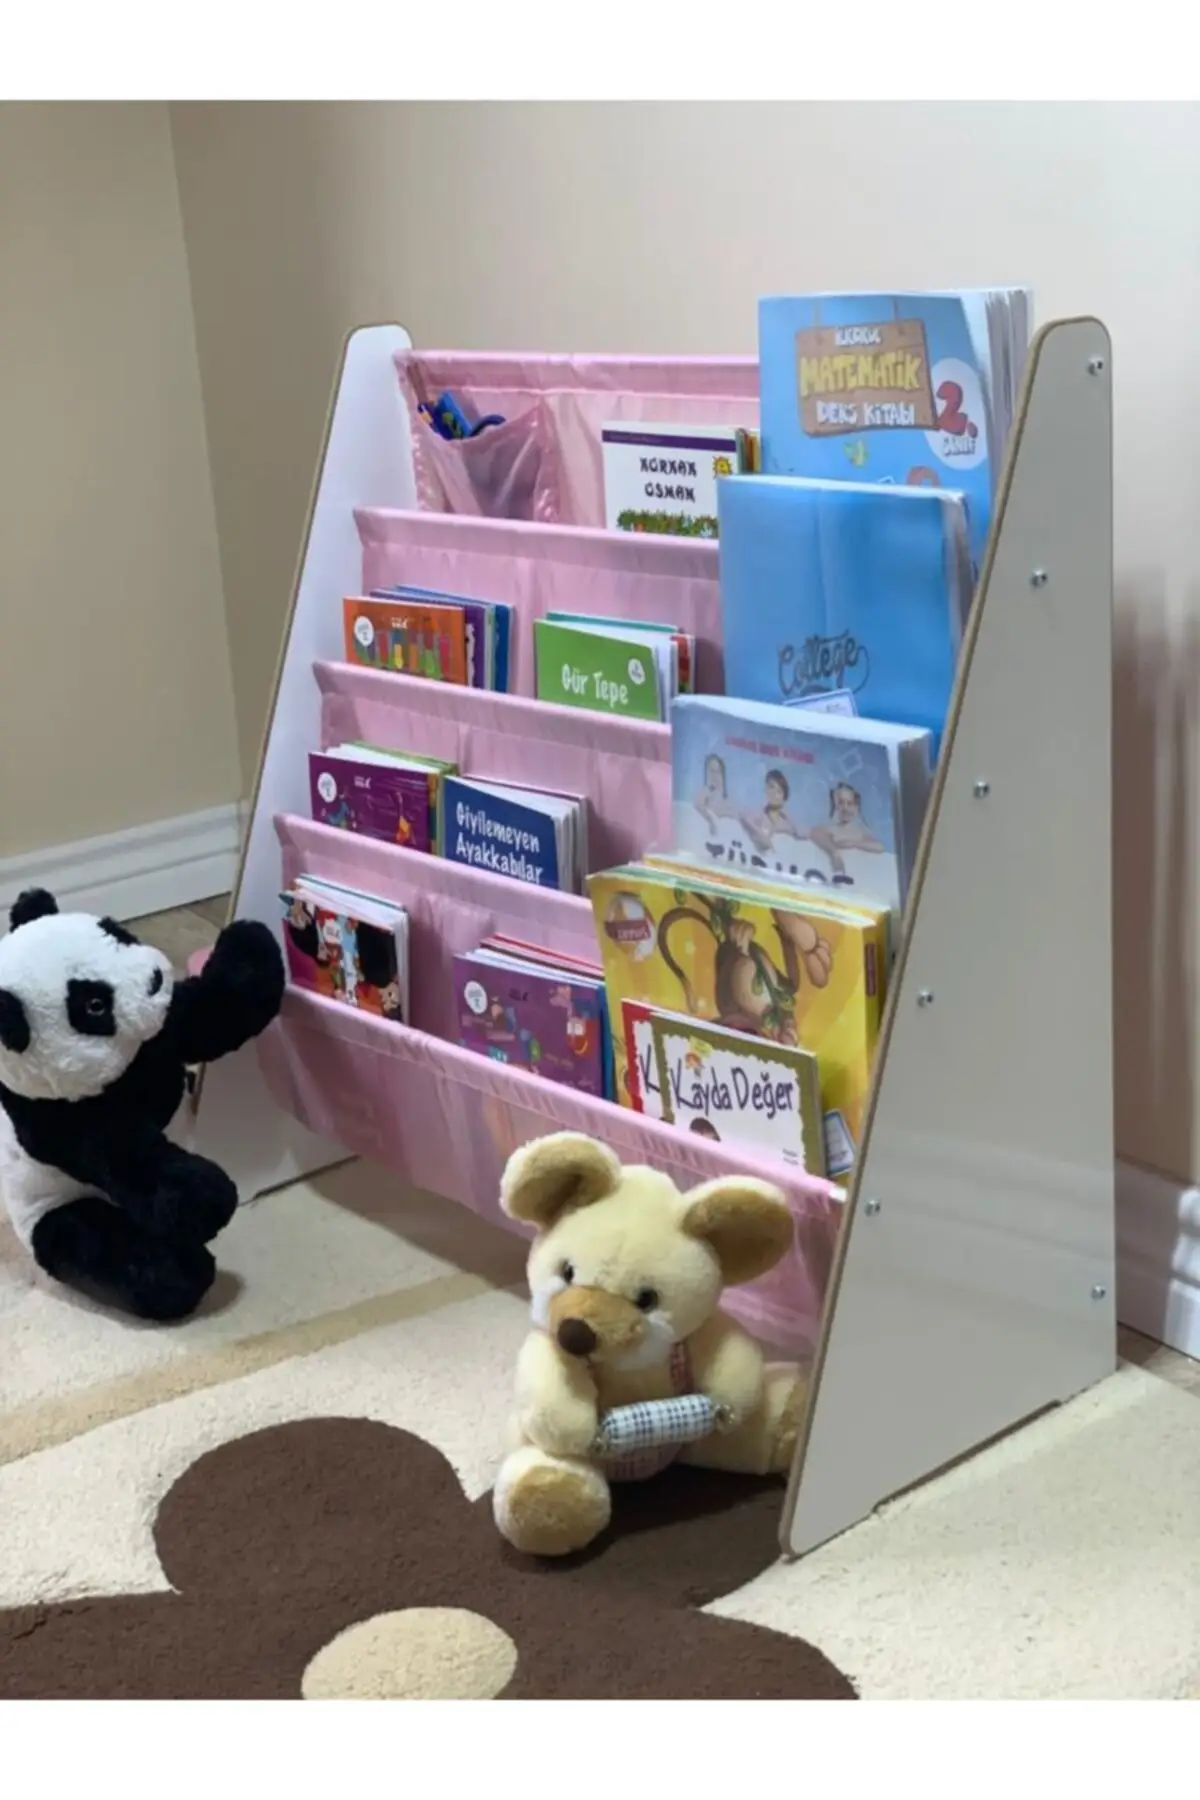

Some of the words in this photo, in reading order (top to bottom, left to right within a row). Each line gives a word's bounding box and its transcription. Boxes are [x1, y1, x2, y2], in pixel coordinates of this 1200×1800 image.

[800, 350, 922, 397] MATEMATİK
[561, 663, 589, 696] Gür
[593, 671, 629, 709] Tepe
[456, 801, 540, 853] Giyilemeyen
[456, 831, 544, 885] Ayakkabılar
[671, 1058, 733, 1117] Kayda
[731, 1066, 793, 1119] Değer
